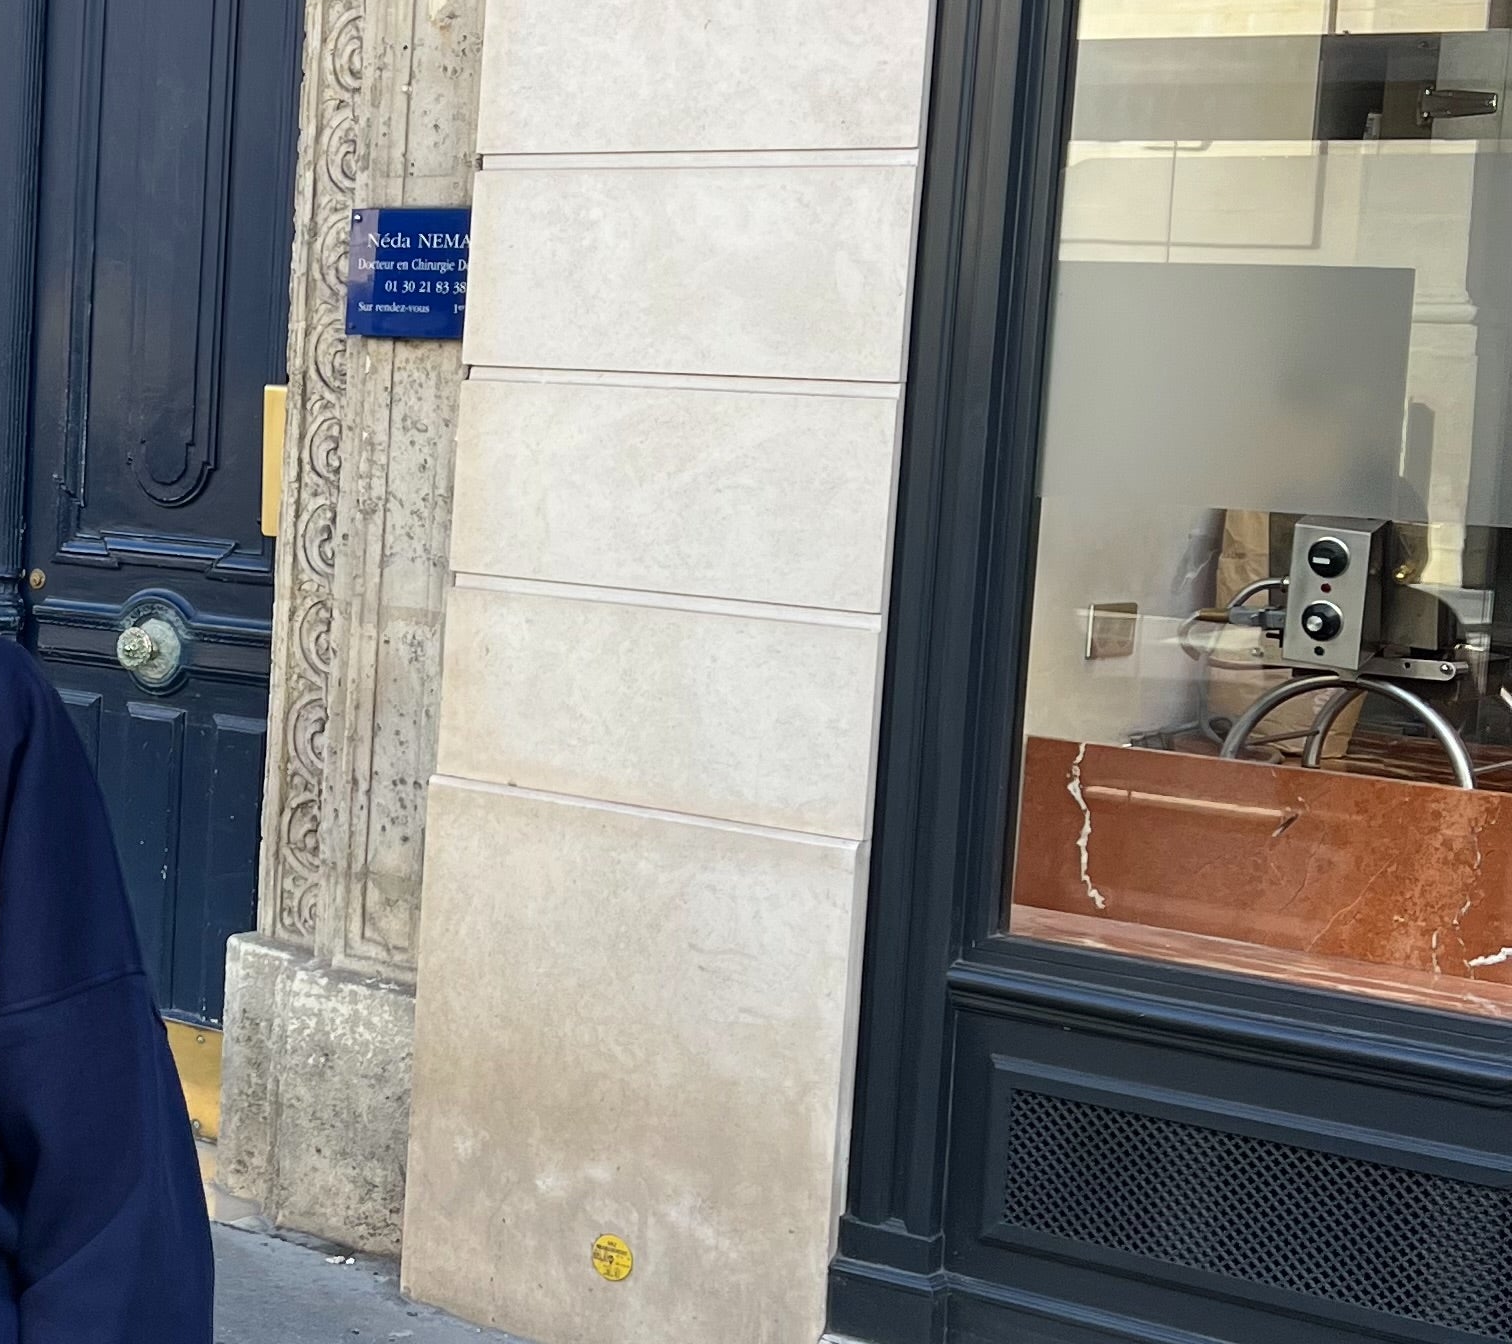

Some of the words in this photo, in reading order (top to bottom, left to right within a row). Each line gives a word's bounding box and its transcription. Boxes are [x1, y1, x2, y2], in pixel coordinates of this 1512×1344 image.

[368, 232, 411, 249] Néda
[358, 258, 394, 270] Docteur
[396, 261, 408, 270] en
[411, 258, 455, 274] Chirurgie
[458, 259, 468, 271] D
[385, 280, 397, 293] 01
[402, 280, 416, 294] 30
[419, 280, 431, 293] 21
[435, 281, 449, 294] 83
[358, 301, 373, 312] Sur
[375, 302, 430, 313] rendez-vous
